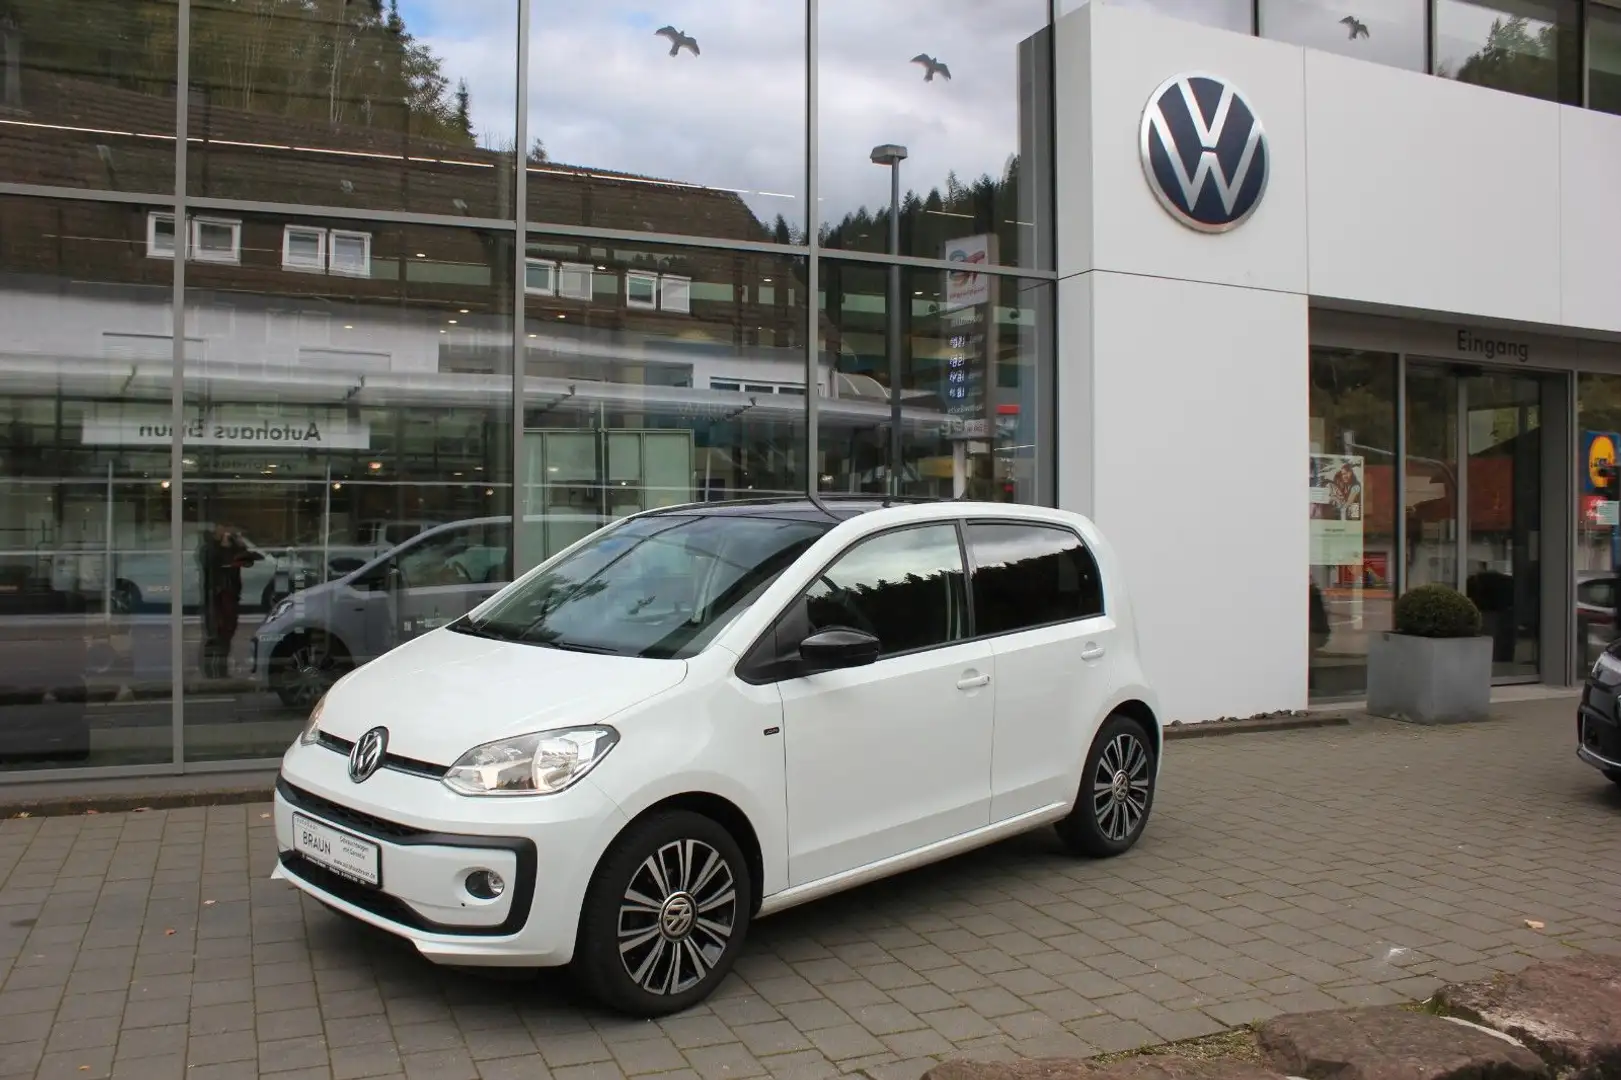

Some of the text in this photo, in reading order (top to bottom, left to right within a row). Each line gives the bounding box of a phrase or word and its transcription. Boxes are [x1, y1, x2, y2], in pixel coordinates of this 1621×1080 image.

[1144, 74, 1267, 220] VW
[1457, 329, 1529, 362] Eingang
[302, 831, 332, 855] BRAUN
